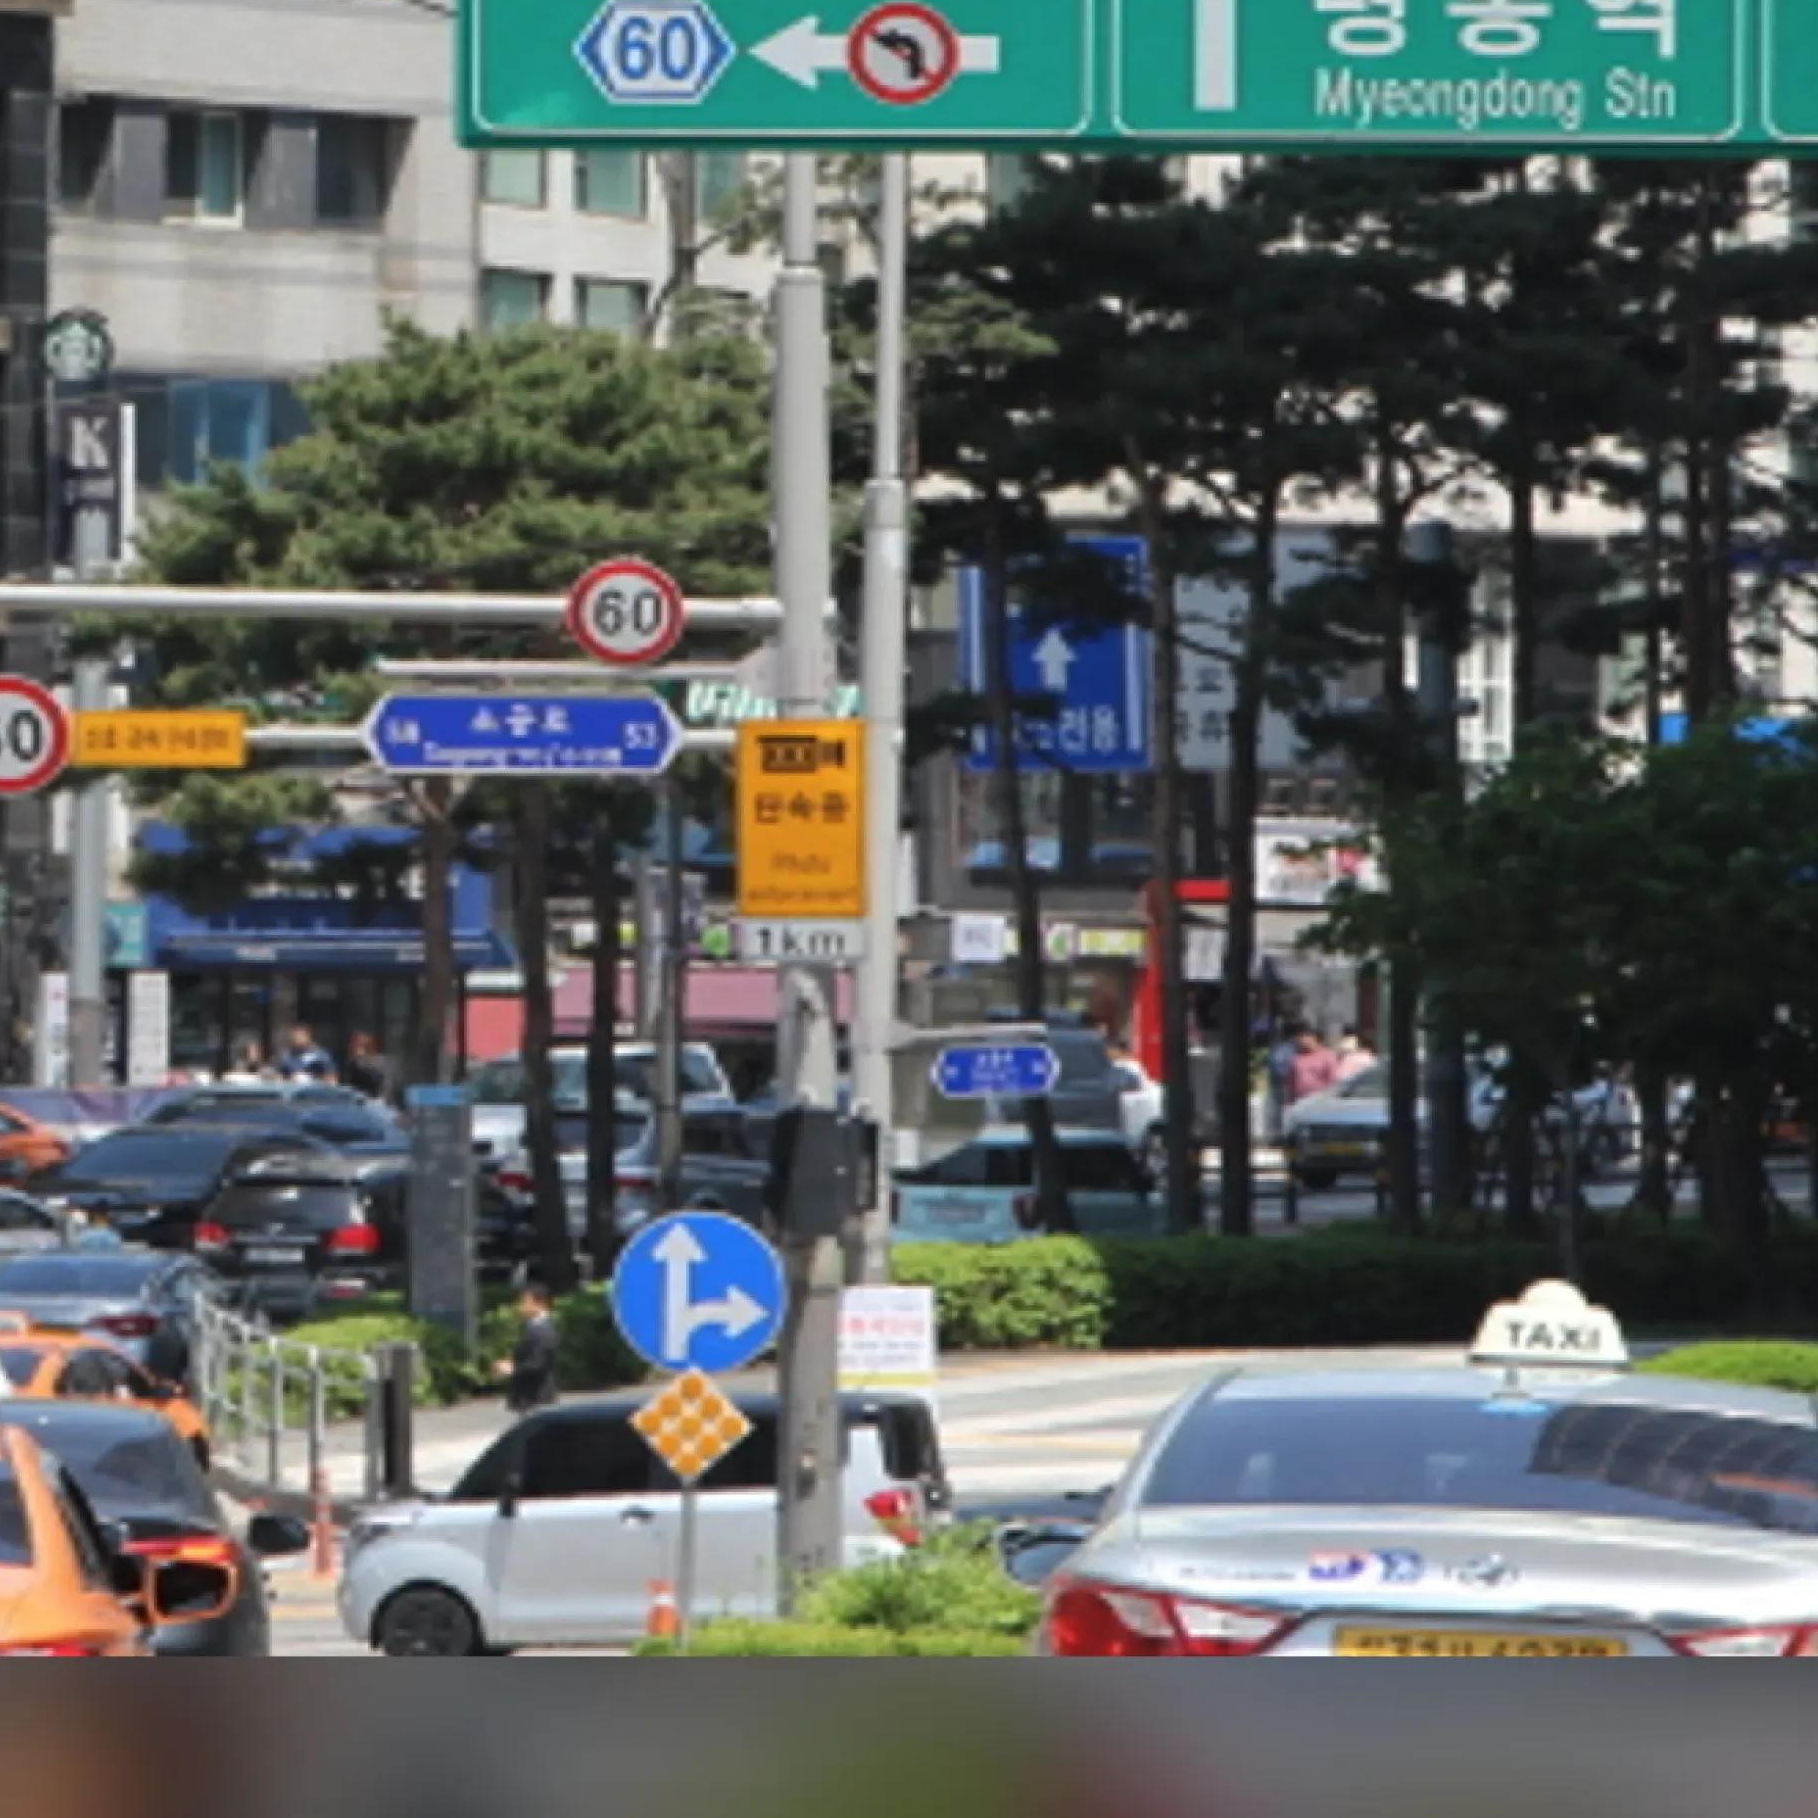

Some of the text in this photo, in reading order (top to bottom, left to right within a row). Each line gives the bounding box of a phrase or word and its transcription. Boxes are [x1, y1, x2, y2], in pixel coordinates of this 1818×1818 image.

[615, 15, 700, 83] 60
[1314, 67, 1677, 132] Myeongdong Stn
[592, 587, 663, 637] 60
[1505, 1319, 1602, 1353] TAXI
